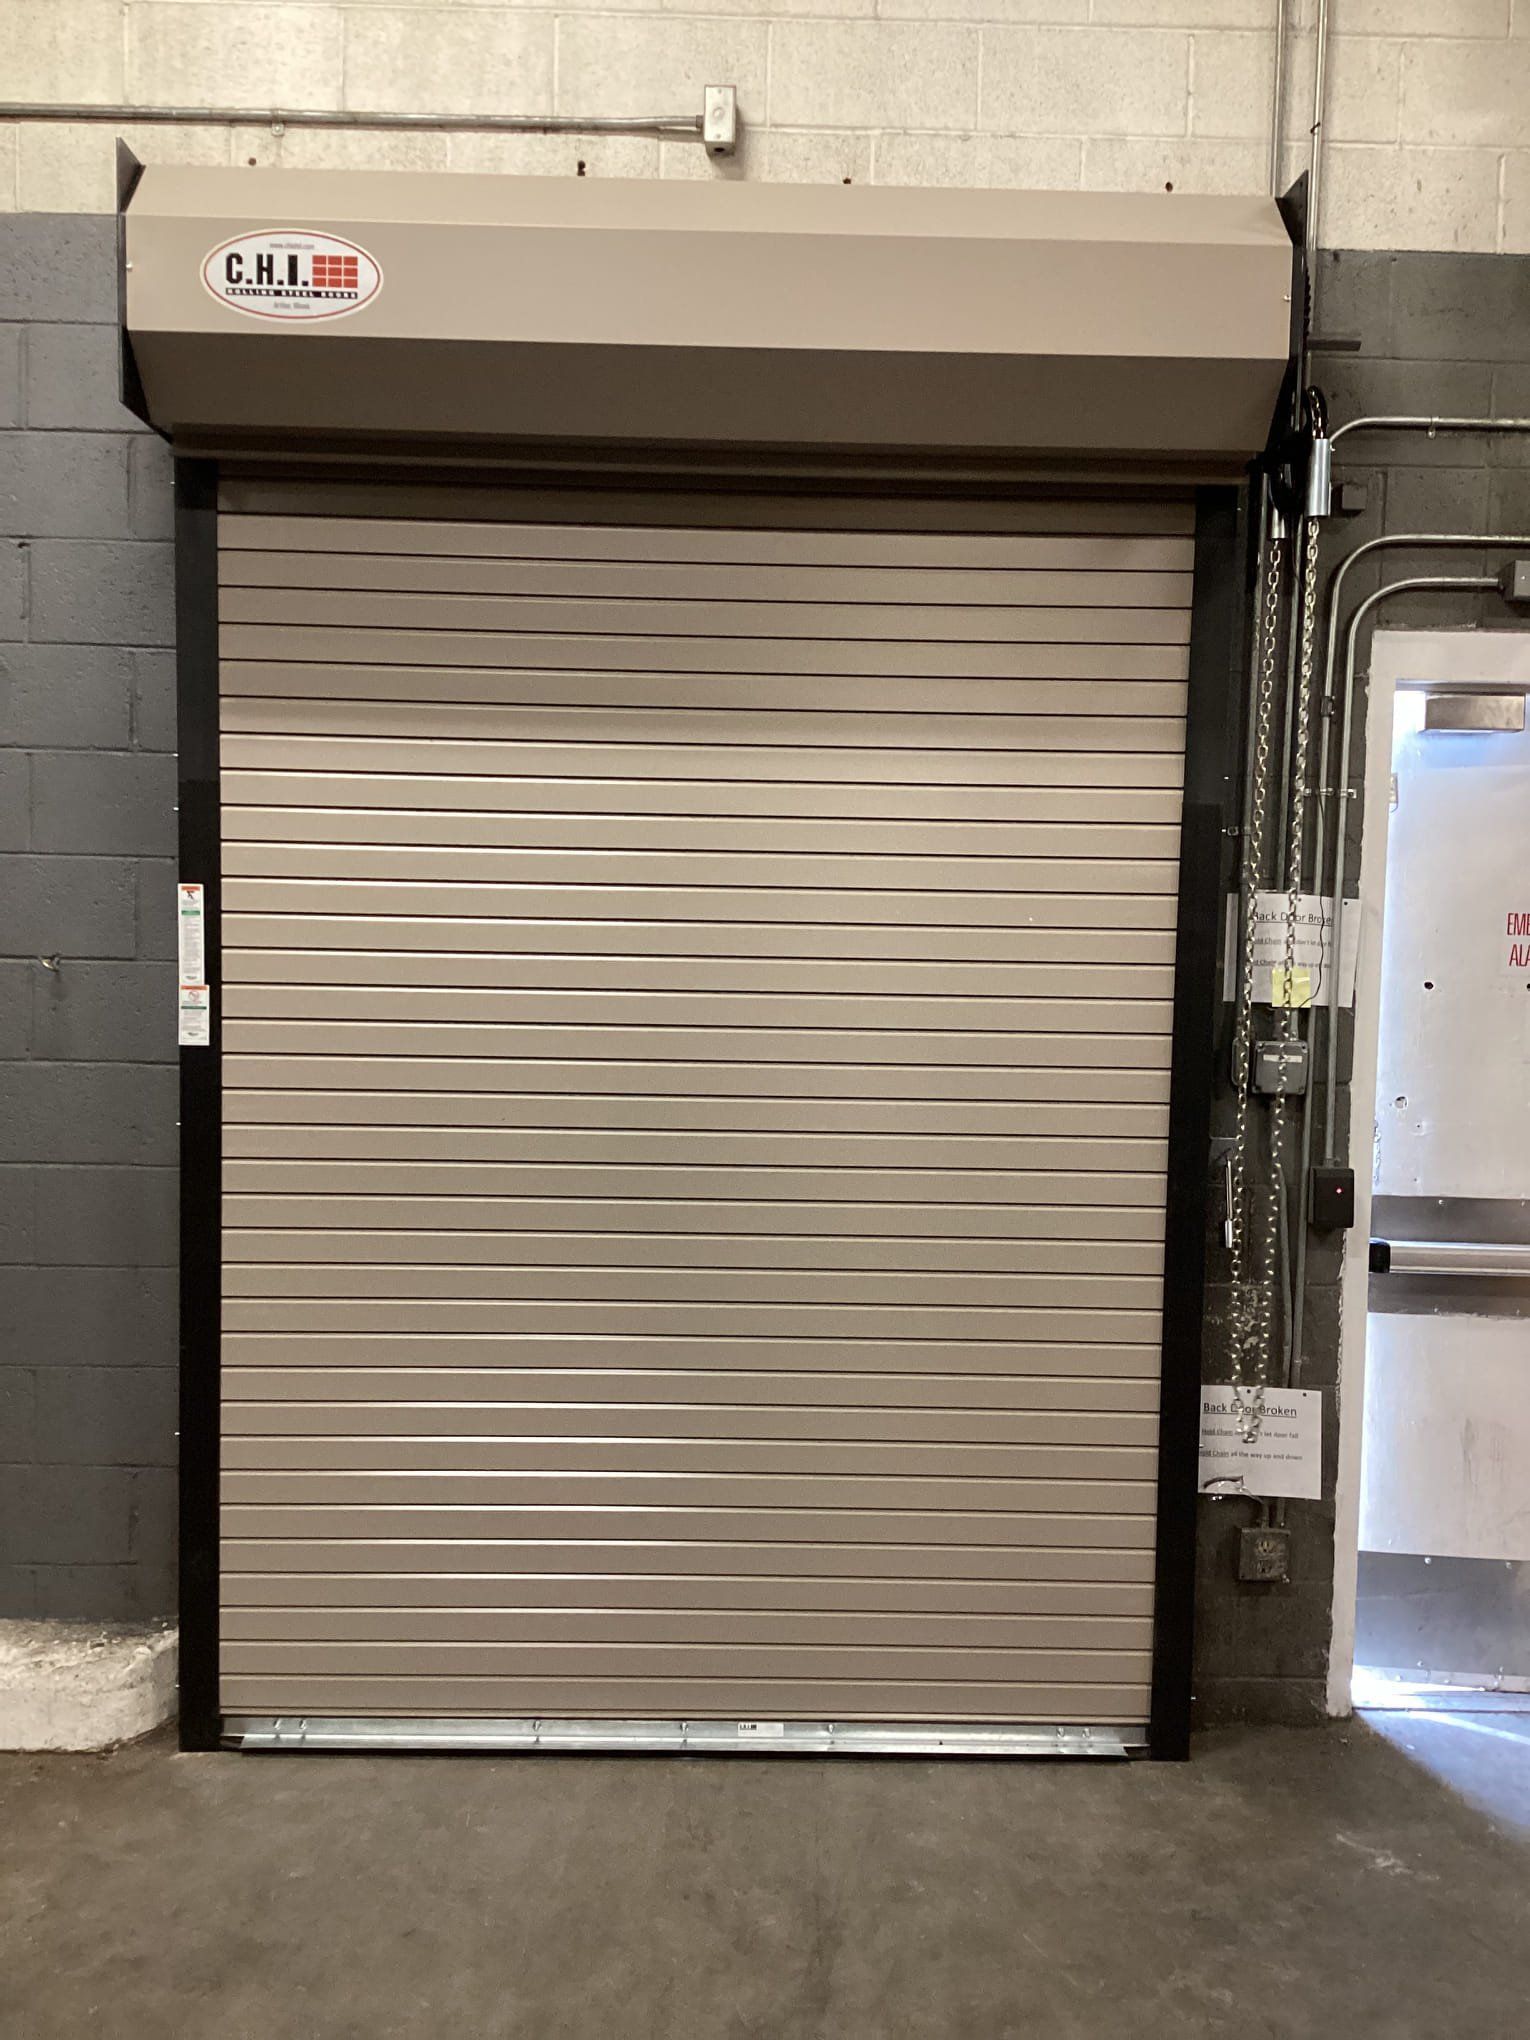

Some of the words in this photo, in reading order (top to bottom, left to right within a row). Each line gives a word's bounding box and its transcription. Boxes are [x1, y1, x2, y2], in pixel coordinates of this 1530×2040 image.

[225, 252, 309, 287] C.H.I.
[281, 290, 314, 298] STEEL
[1281, 911, 1305, 922] Dor
[1203, 1402, 1227, 1412] Back
[1260, 1405, 1297, 1416] Broken
